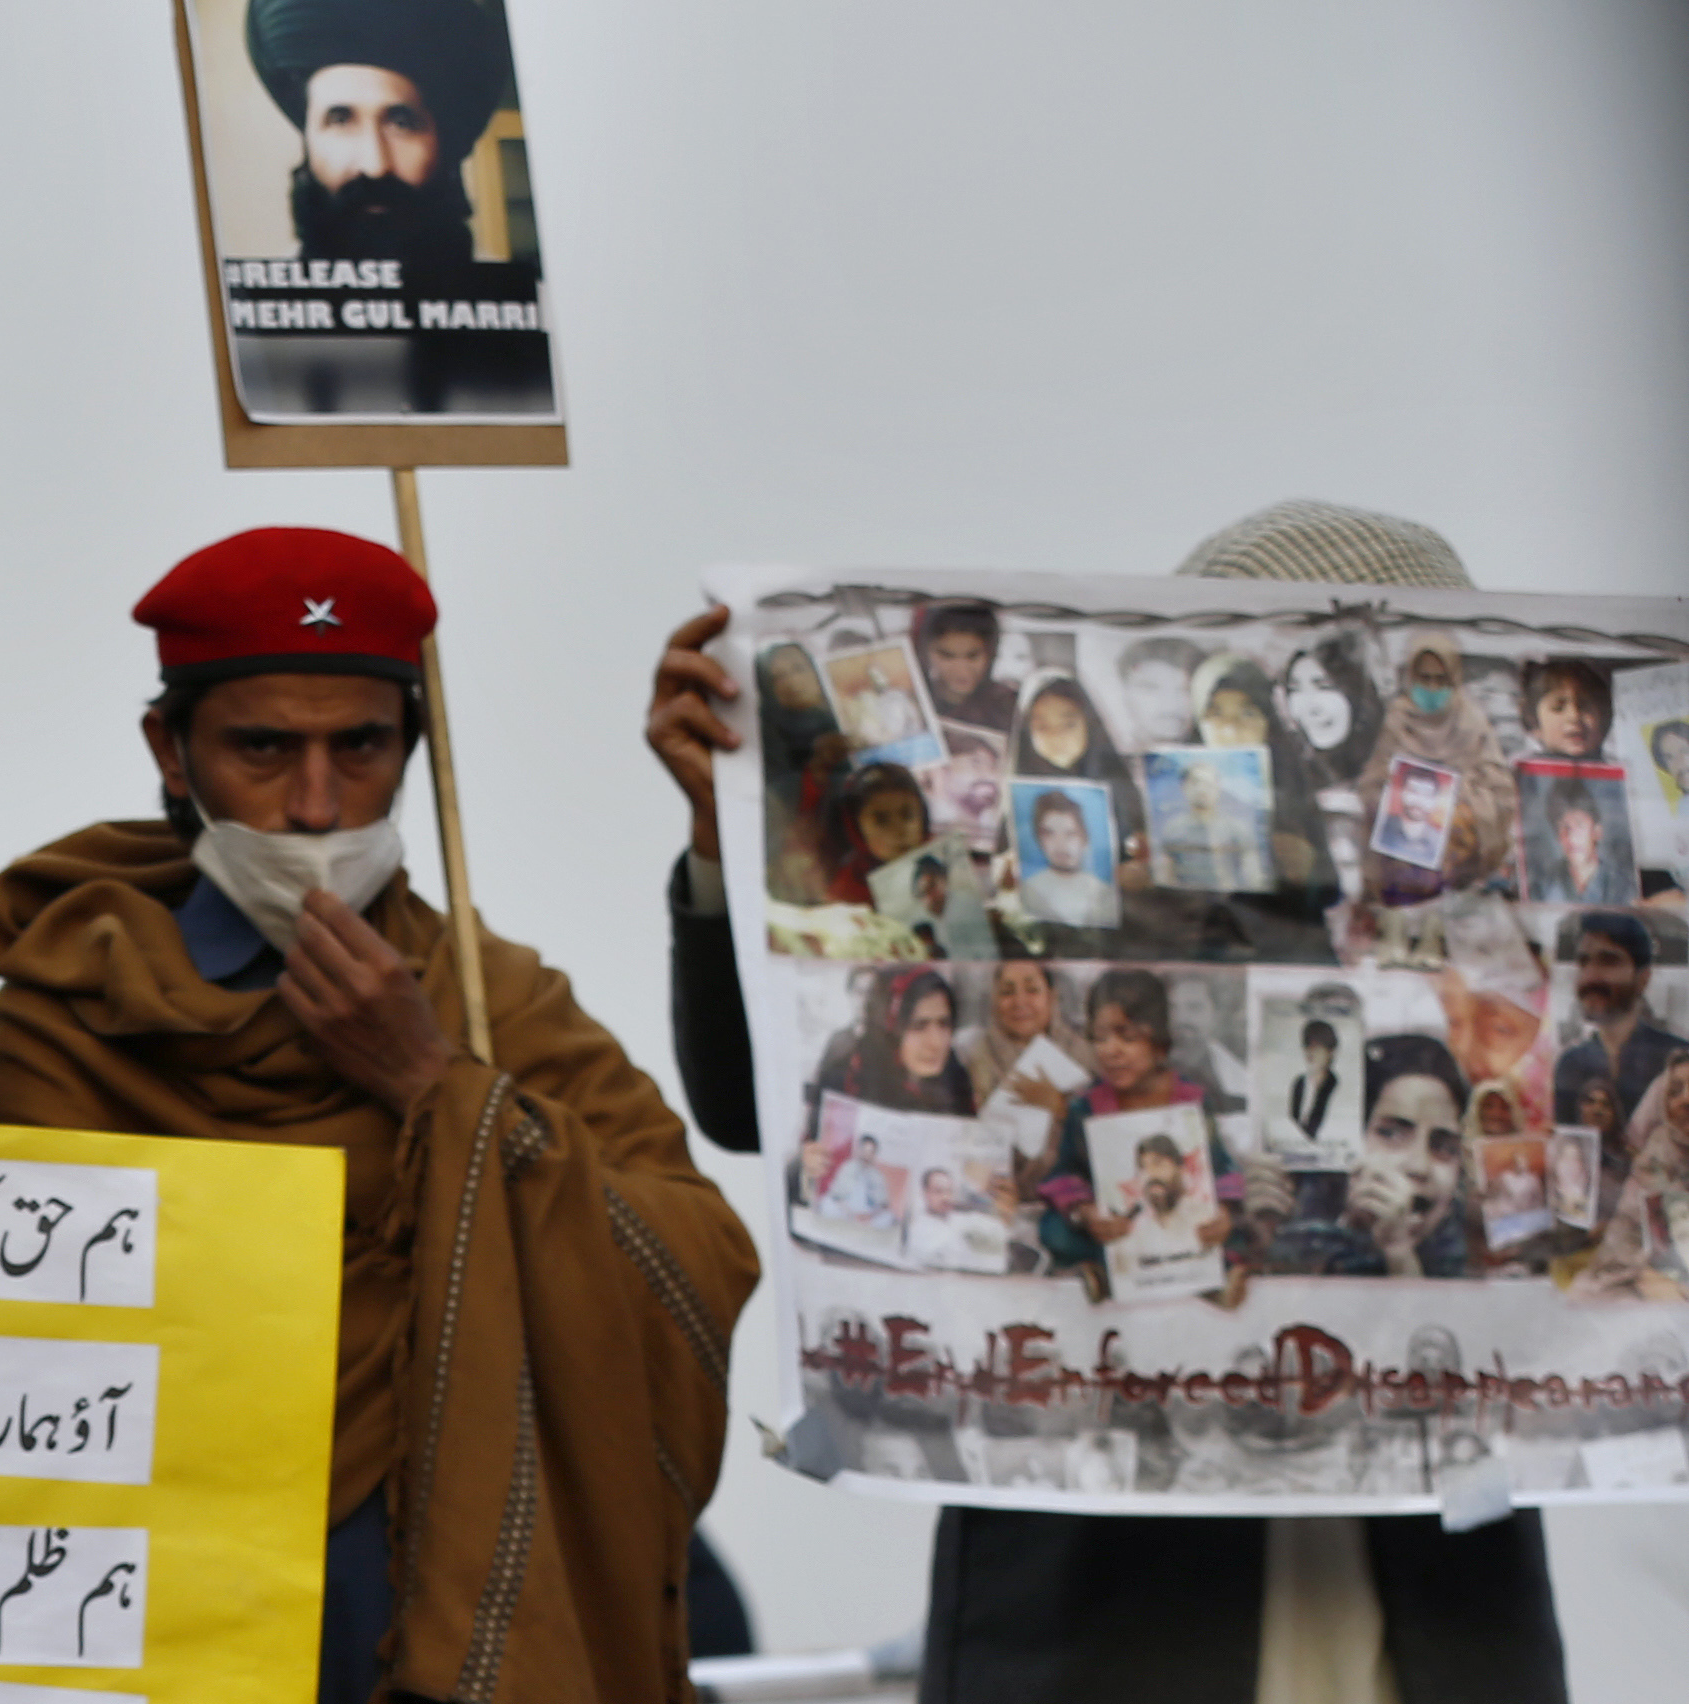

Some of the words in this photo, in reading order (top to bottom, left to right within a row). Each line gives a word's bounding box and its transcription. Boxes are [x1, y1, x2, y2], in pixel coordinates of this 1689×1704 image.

[230, 300, 335, 331] MEHR
[341, 301, 413, 331] GUL
[419, 301, 538, 331] MARRI
[0, 1194, 73, 1276] حق
[79, 1207, 139, 1302] ہم
[69, 1382, 133, 1455] آؤ
[78, 1560, 136, 1657] ہم
